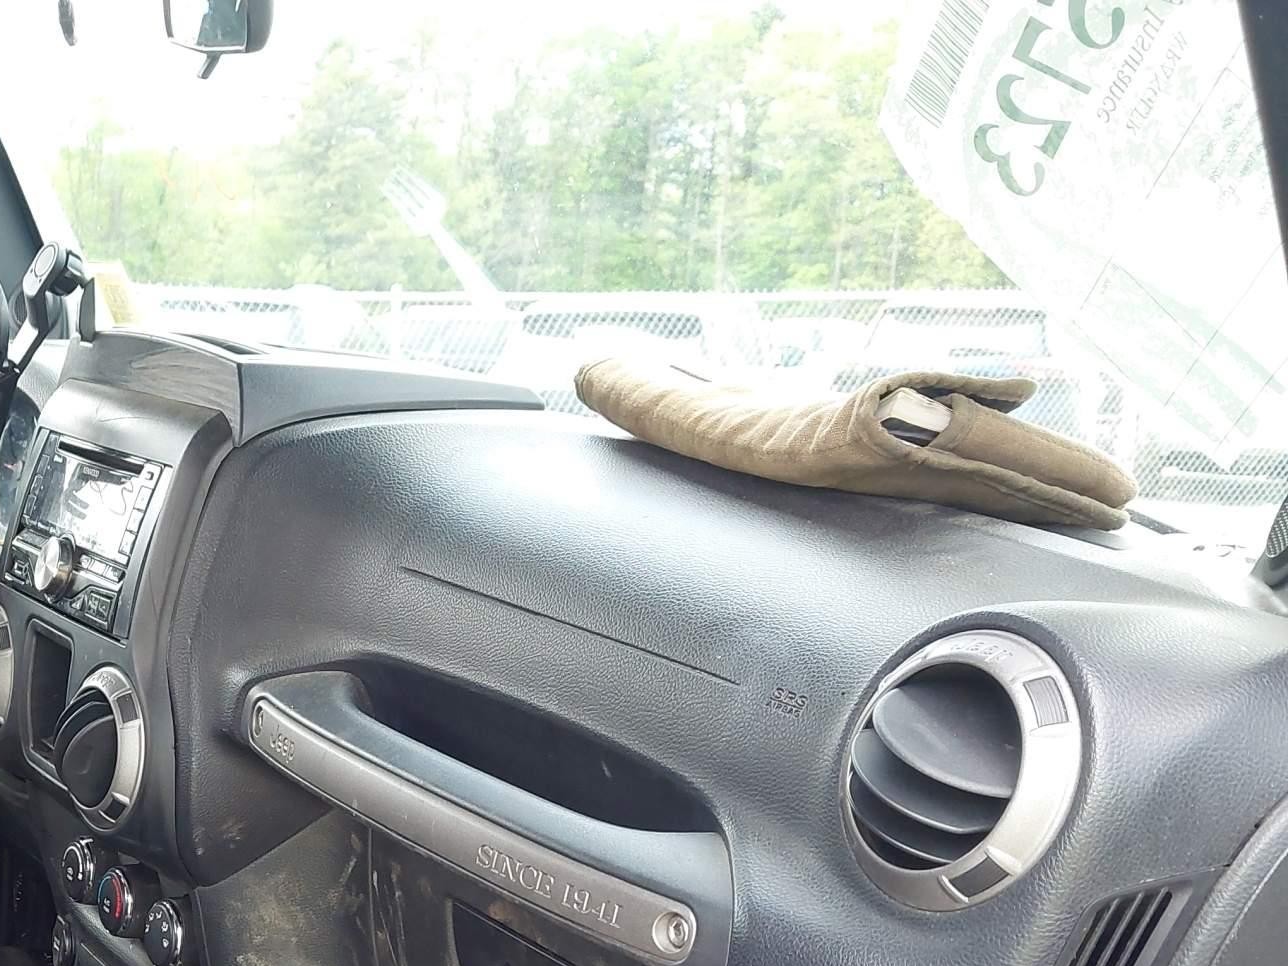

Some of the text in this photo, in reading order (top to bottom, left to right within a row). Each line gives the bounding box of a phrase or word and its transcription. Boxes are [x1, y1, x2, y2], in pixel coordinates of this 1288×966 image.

[267, 724, 296, 763] Jeep
[475, 843, 624, 930] SINCE 1941
